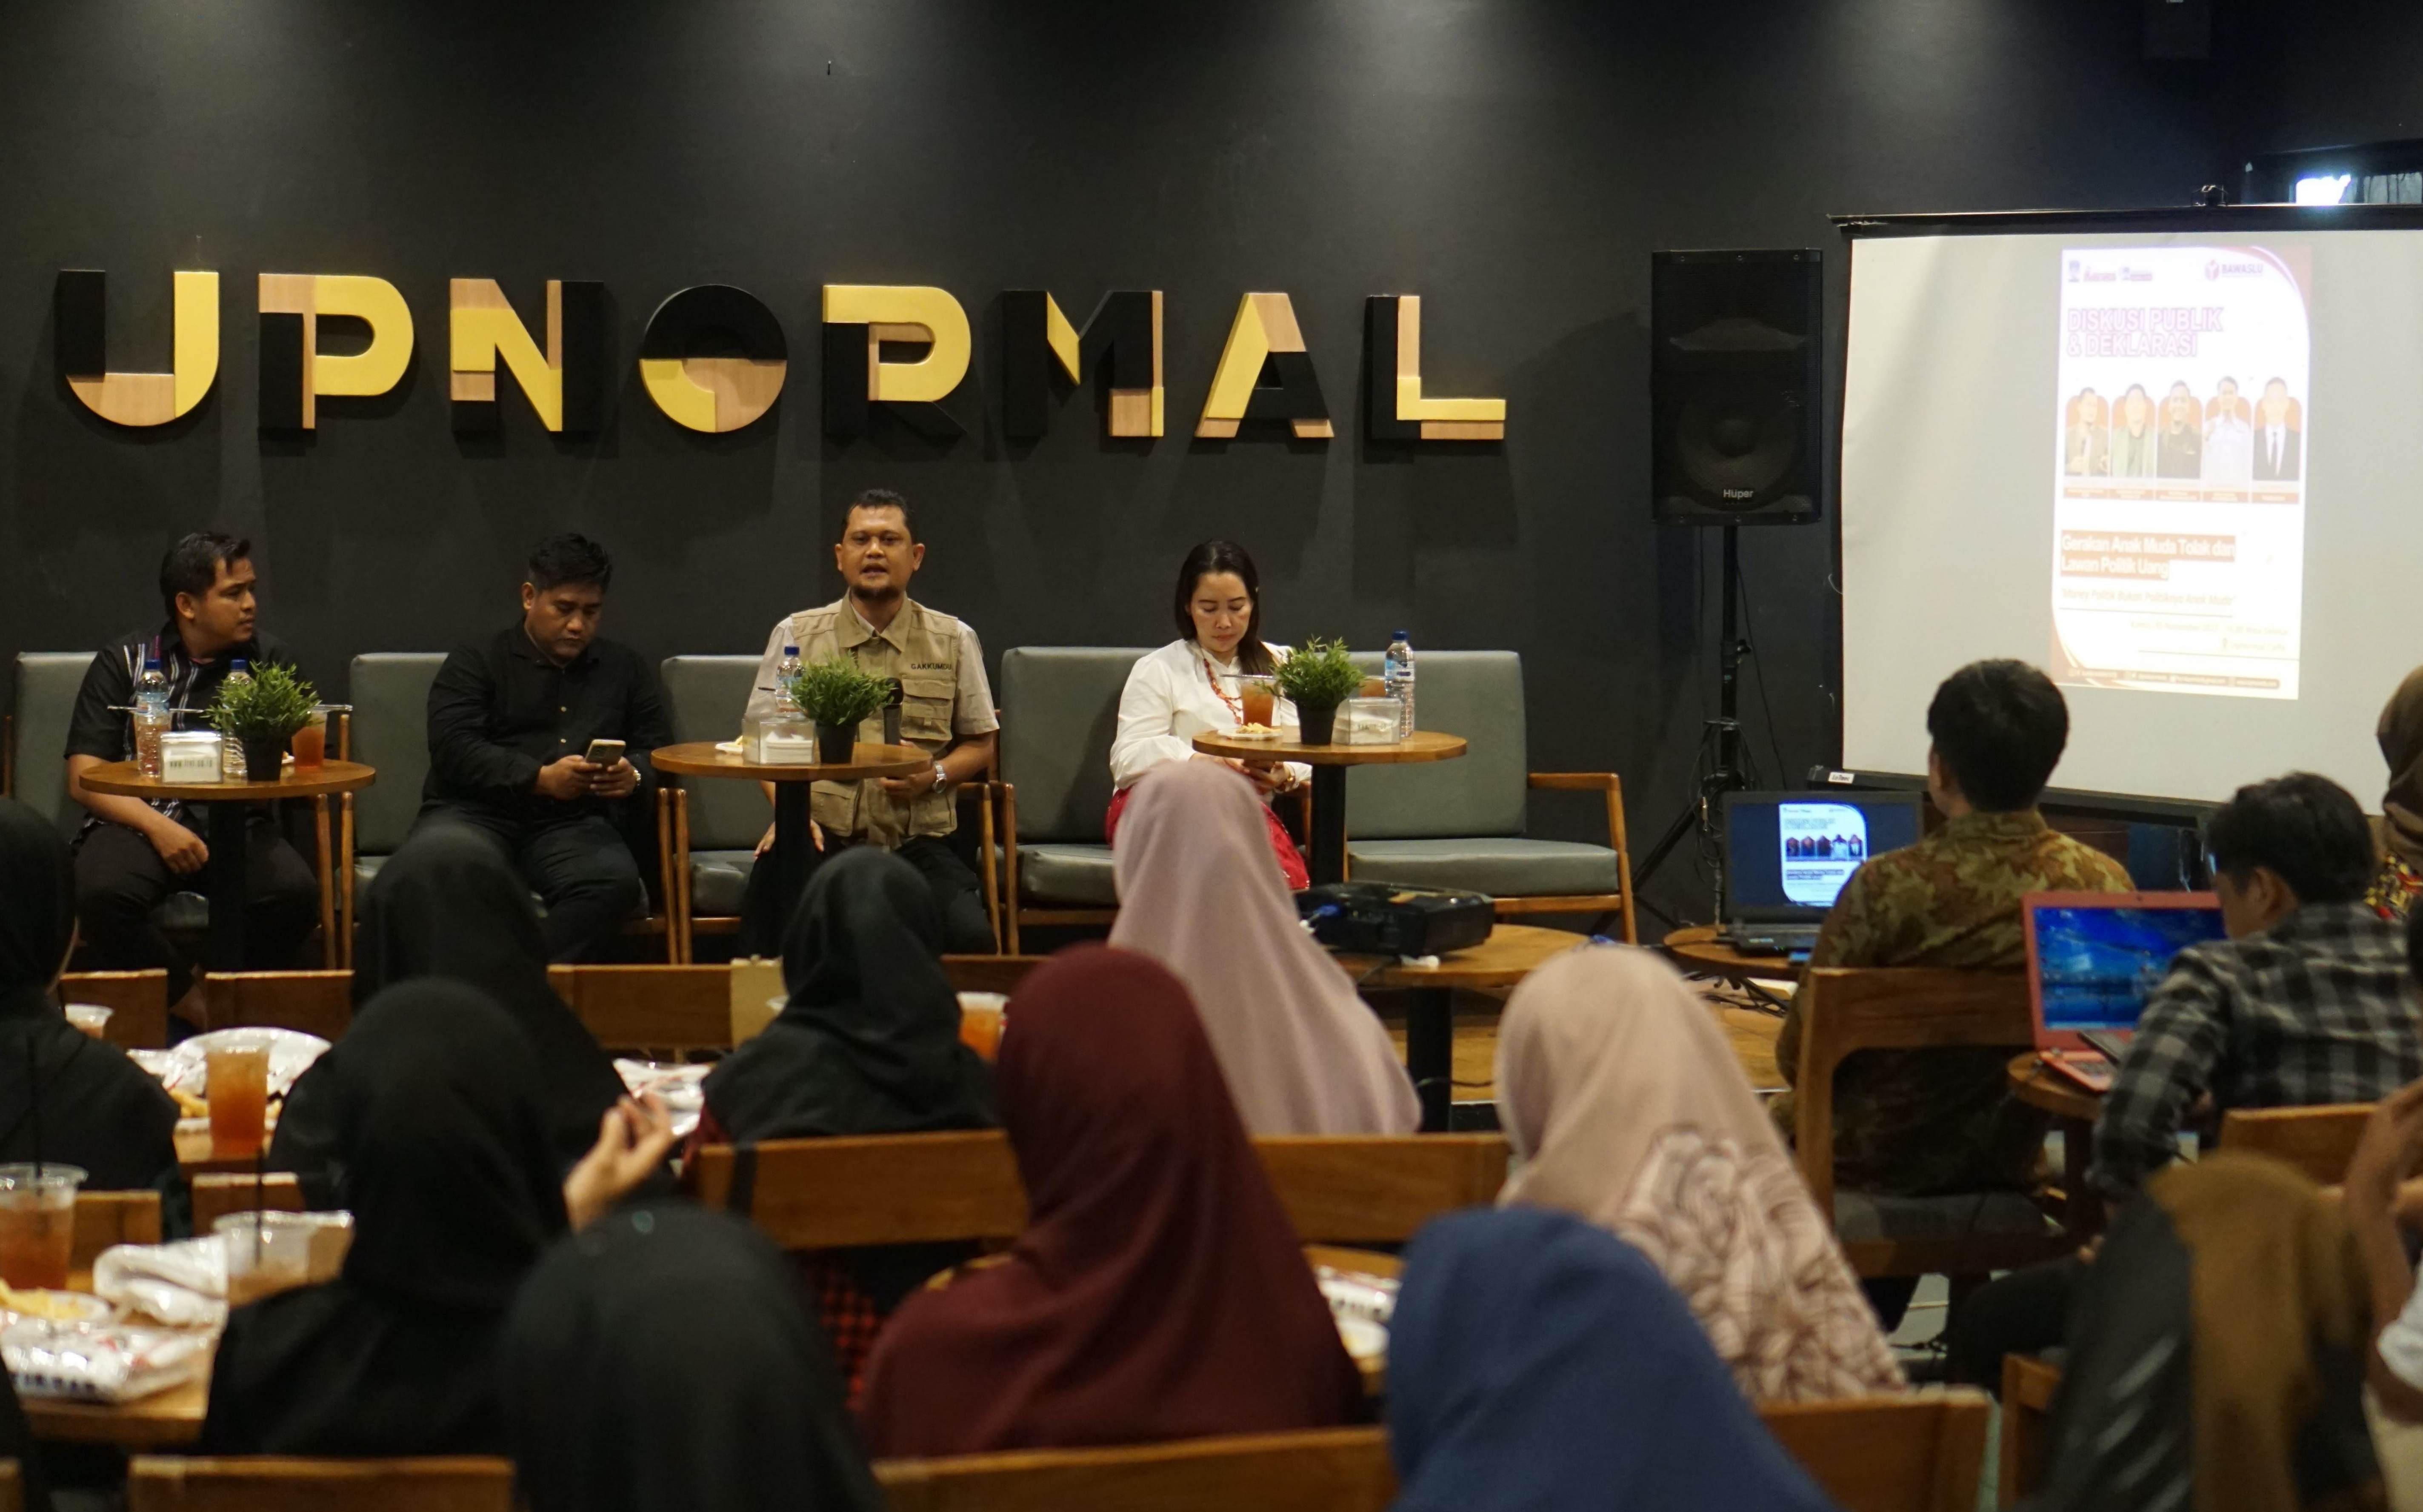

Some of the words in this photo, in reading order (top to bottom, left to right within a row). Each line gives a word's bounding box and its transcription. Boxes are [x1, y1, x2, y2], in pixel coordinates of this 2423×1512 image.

[2222, 263, 2263, 274] BAWASLU
[2067, 307, 2145, 332] DISKUSI
[2149, 306, 2225, 332] PUBLIK
[58, 268, 1506, 439] UPNORMAL
[2066, 331, 2082, 357] &
[2085, 332, 2198, 357] DEKLARASI
[2062, 534, 2110, 552] Gerakan
[2112, 536, 2142, 553] Anak
[2144, 536, 2177, 554] Muda
[2178, 538, 2211, 556] Tolak
[2212, 539, 2236, 557] dan
[2062, 556, 2098, 571] Lawan
[2138, 558, 2169, 579] Uang
